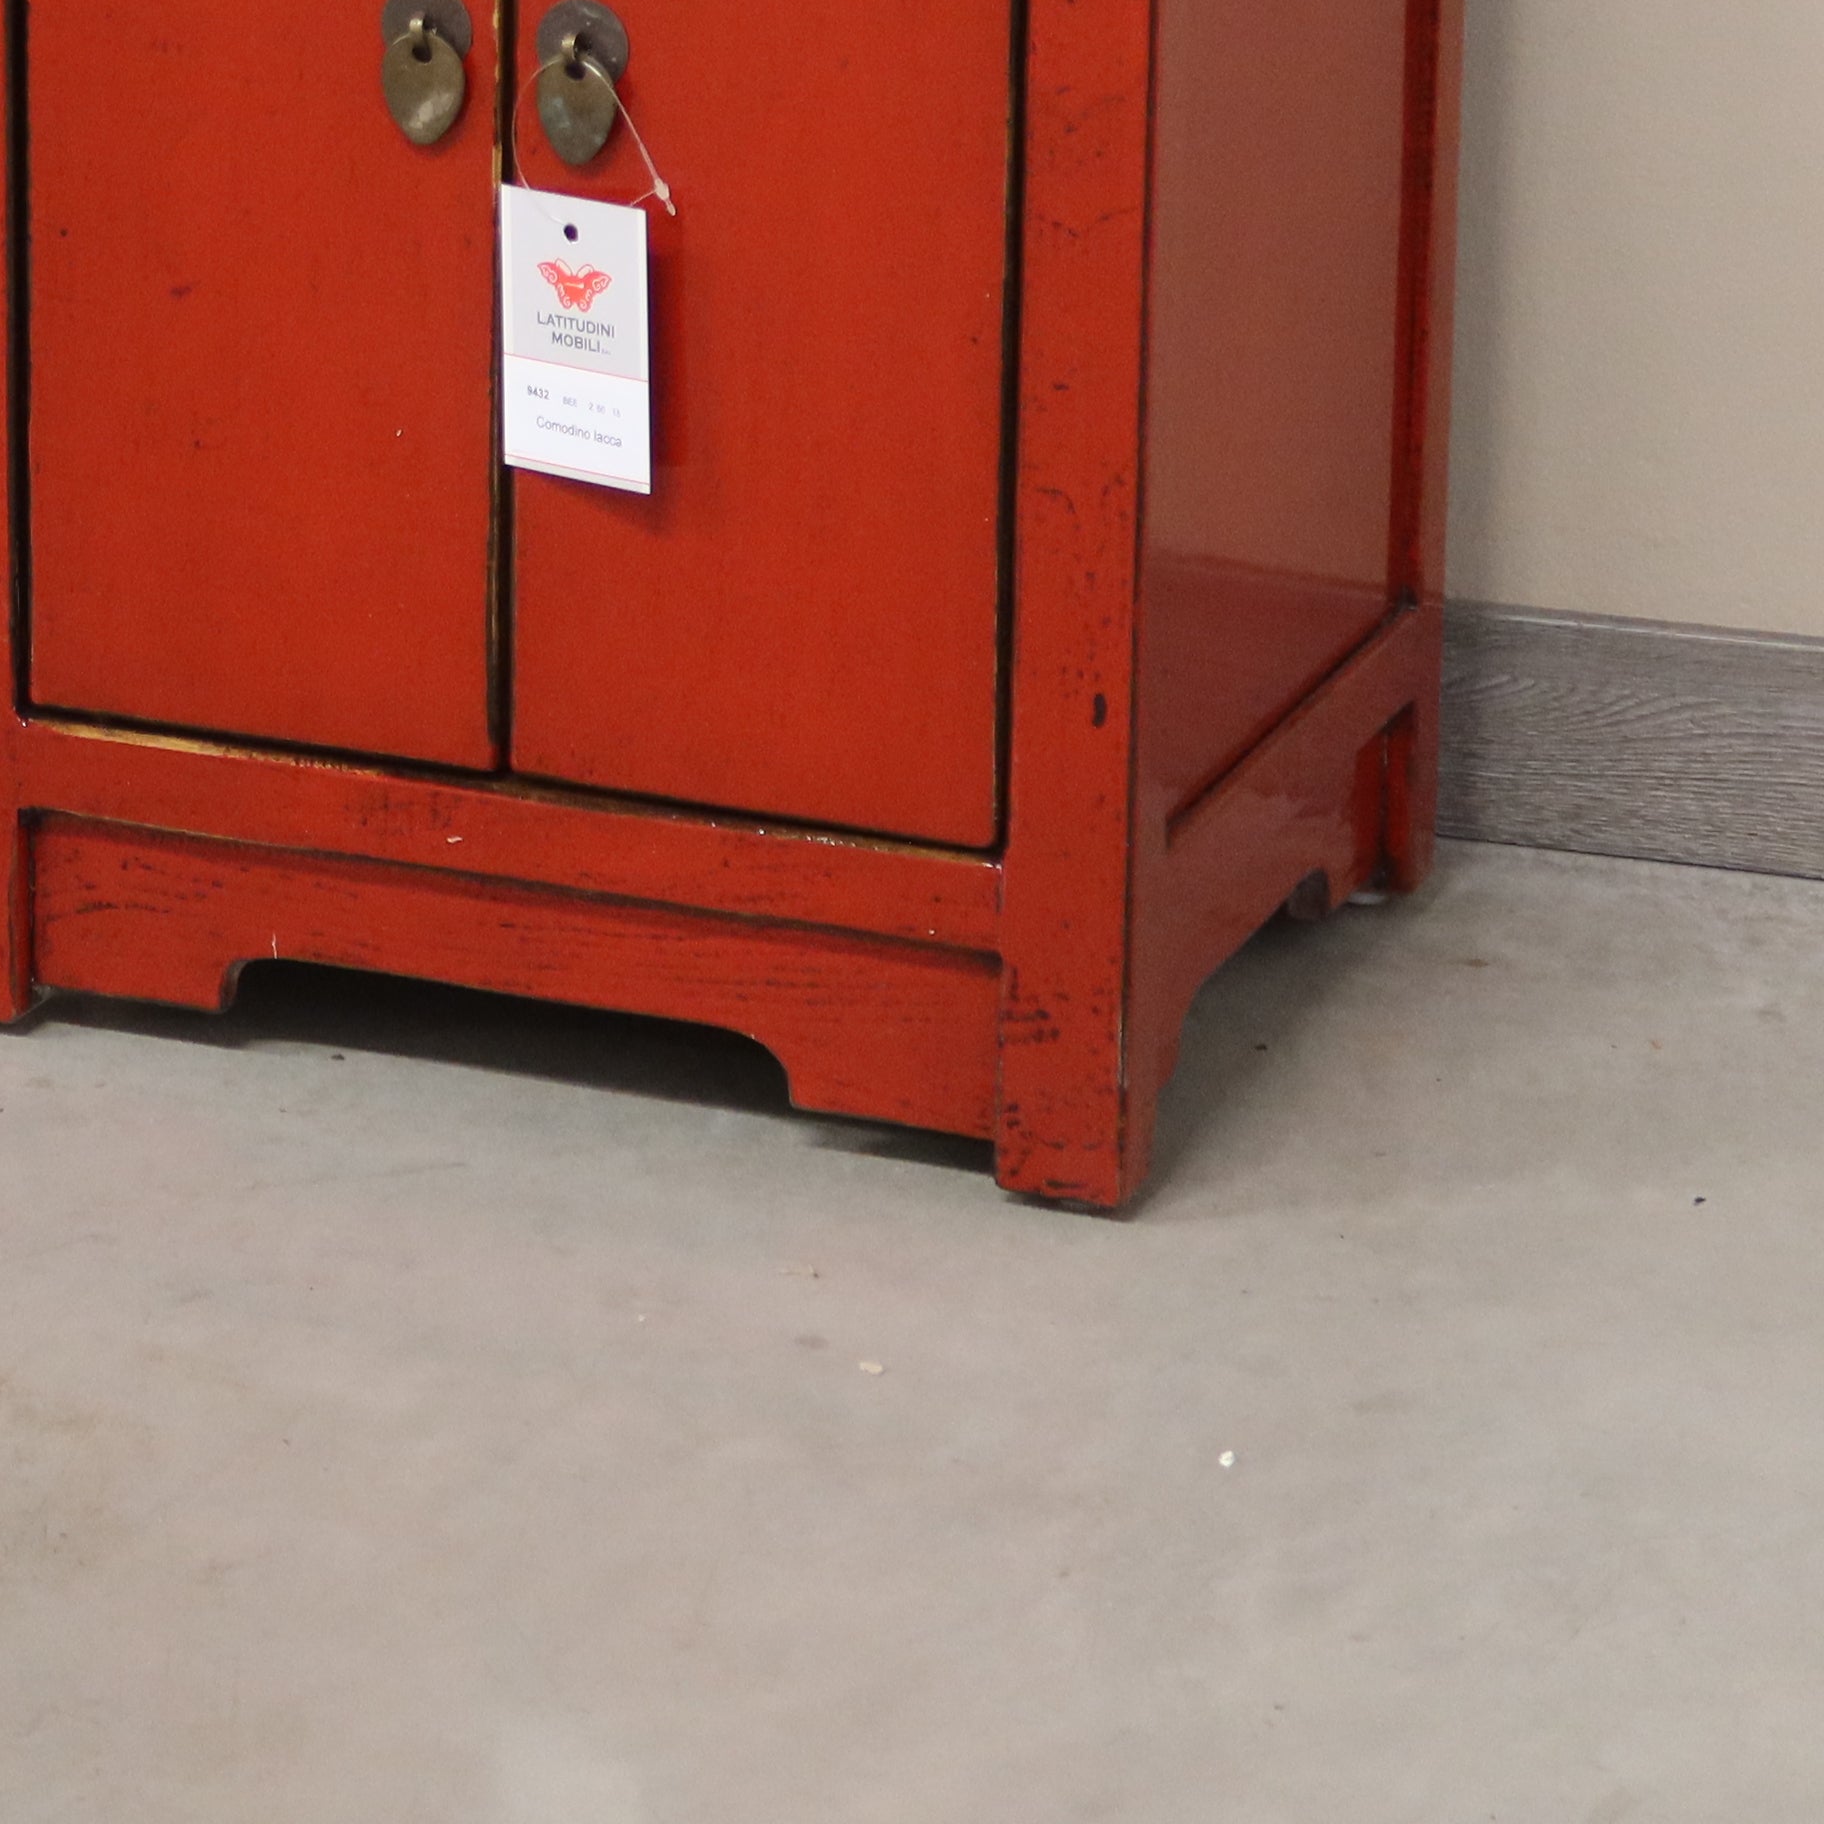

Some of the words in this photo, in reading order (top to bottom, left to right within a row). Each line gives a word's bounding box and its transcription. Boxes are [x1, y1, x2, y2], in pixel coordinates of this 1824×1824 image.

[537, 311, 615, 338] LATITUDINI
[552, 331, 601, 353] MOBILI
[527, 384, 550, 400] 9432
[536, 415, 591, 440] Comodino
[594, 431, 623, 448] lacca
